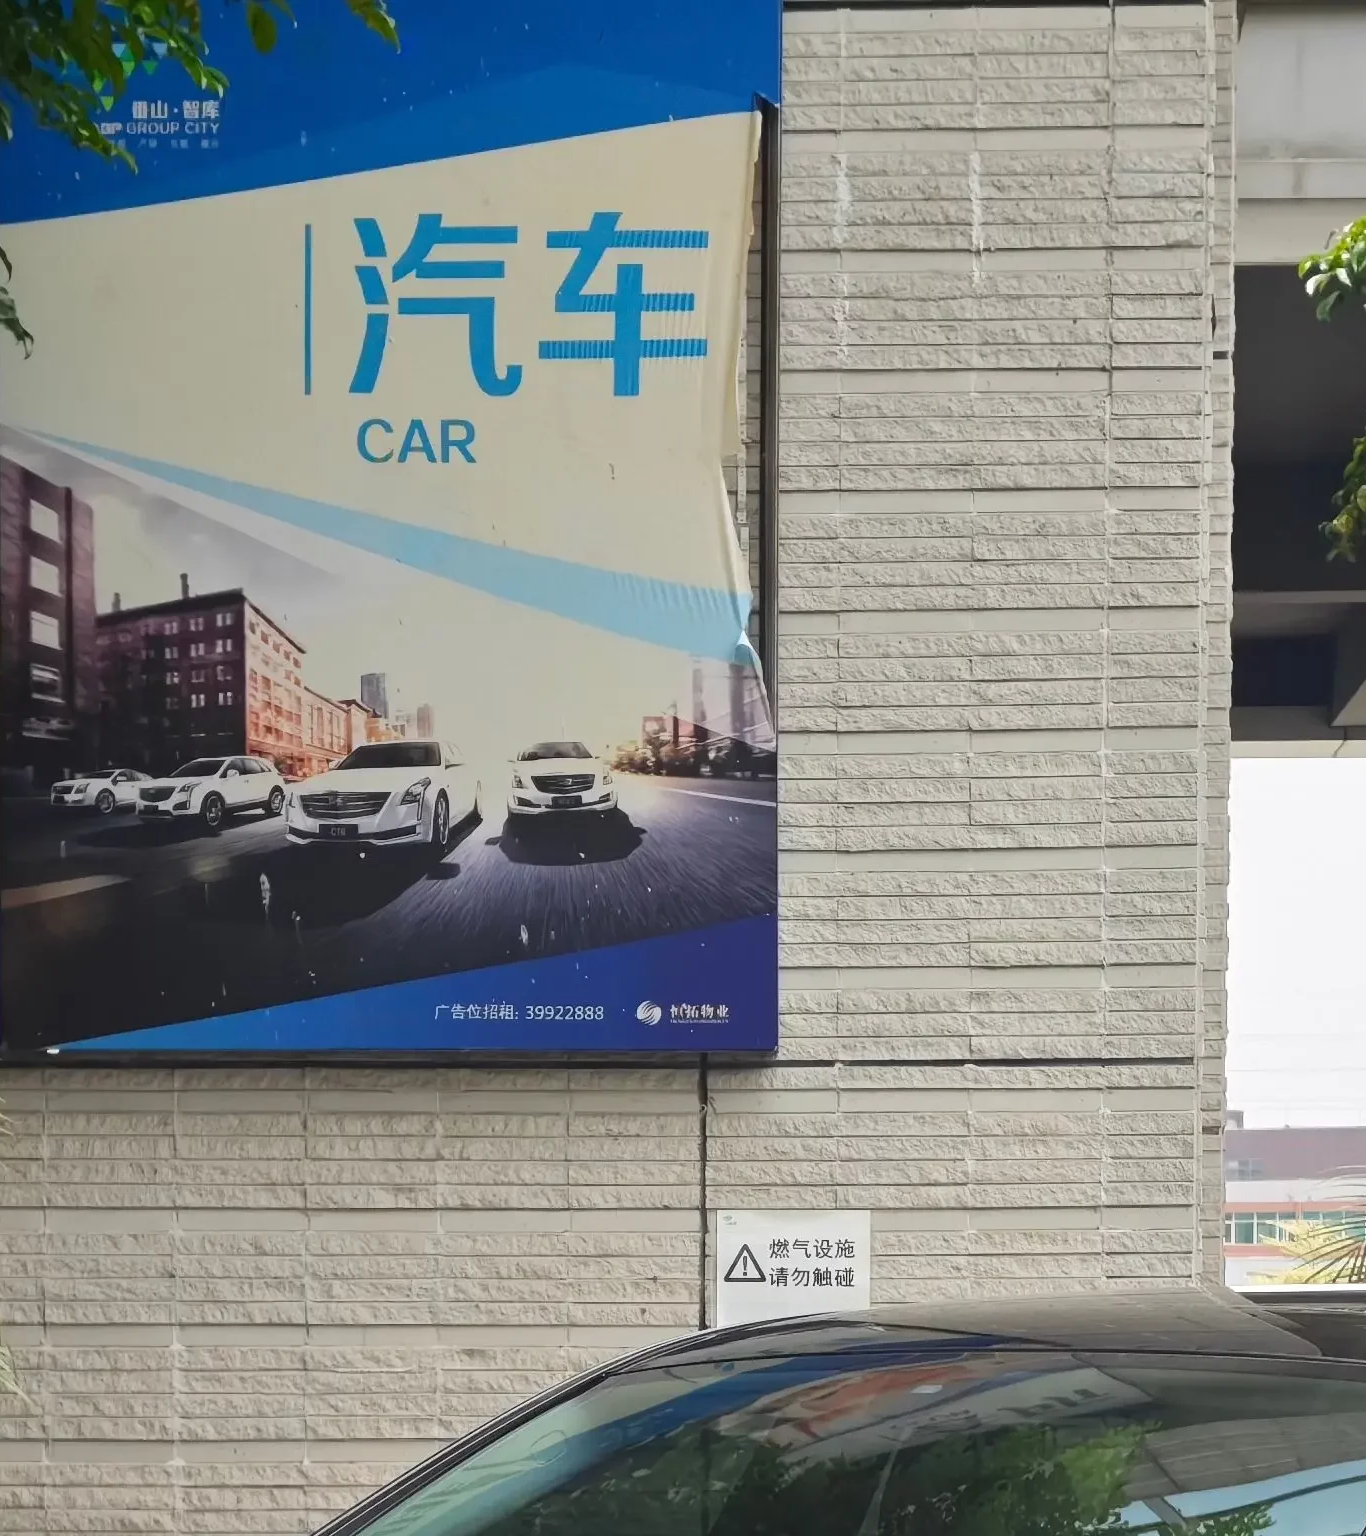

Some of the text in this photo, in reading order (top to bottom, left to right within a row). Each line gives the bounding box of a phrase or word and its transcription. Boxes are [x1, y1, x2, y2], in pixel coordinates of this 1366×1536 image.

[349, 212, 709, 397] 汽车
[356, 418, 477, 464] CAR
[525, 1004, 605, 1020] 39922888
[769, 1238, 856, 1260] 燃气设施
[769, 1266, 856, 1288] 请勿触碰
